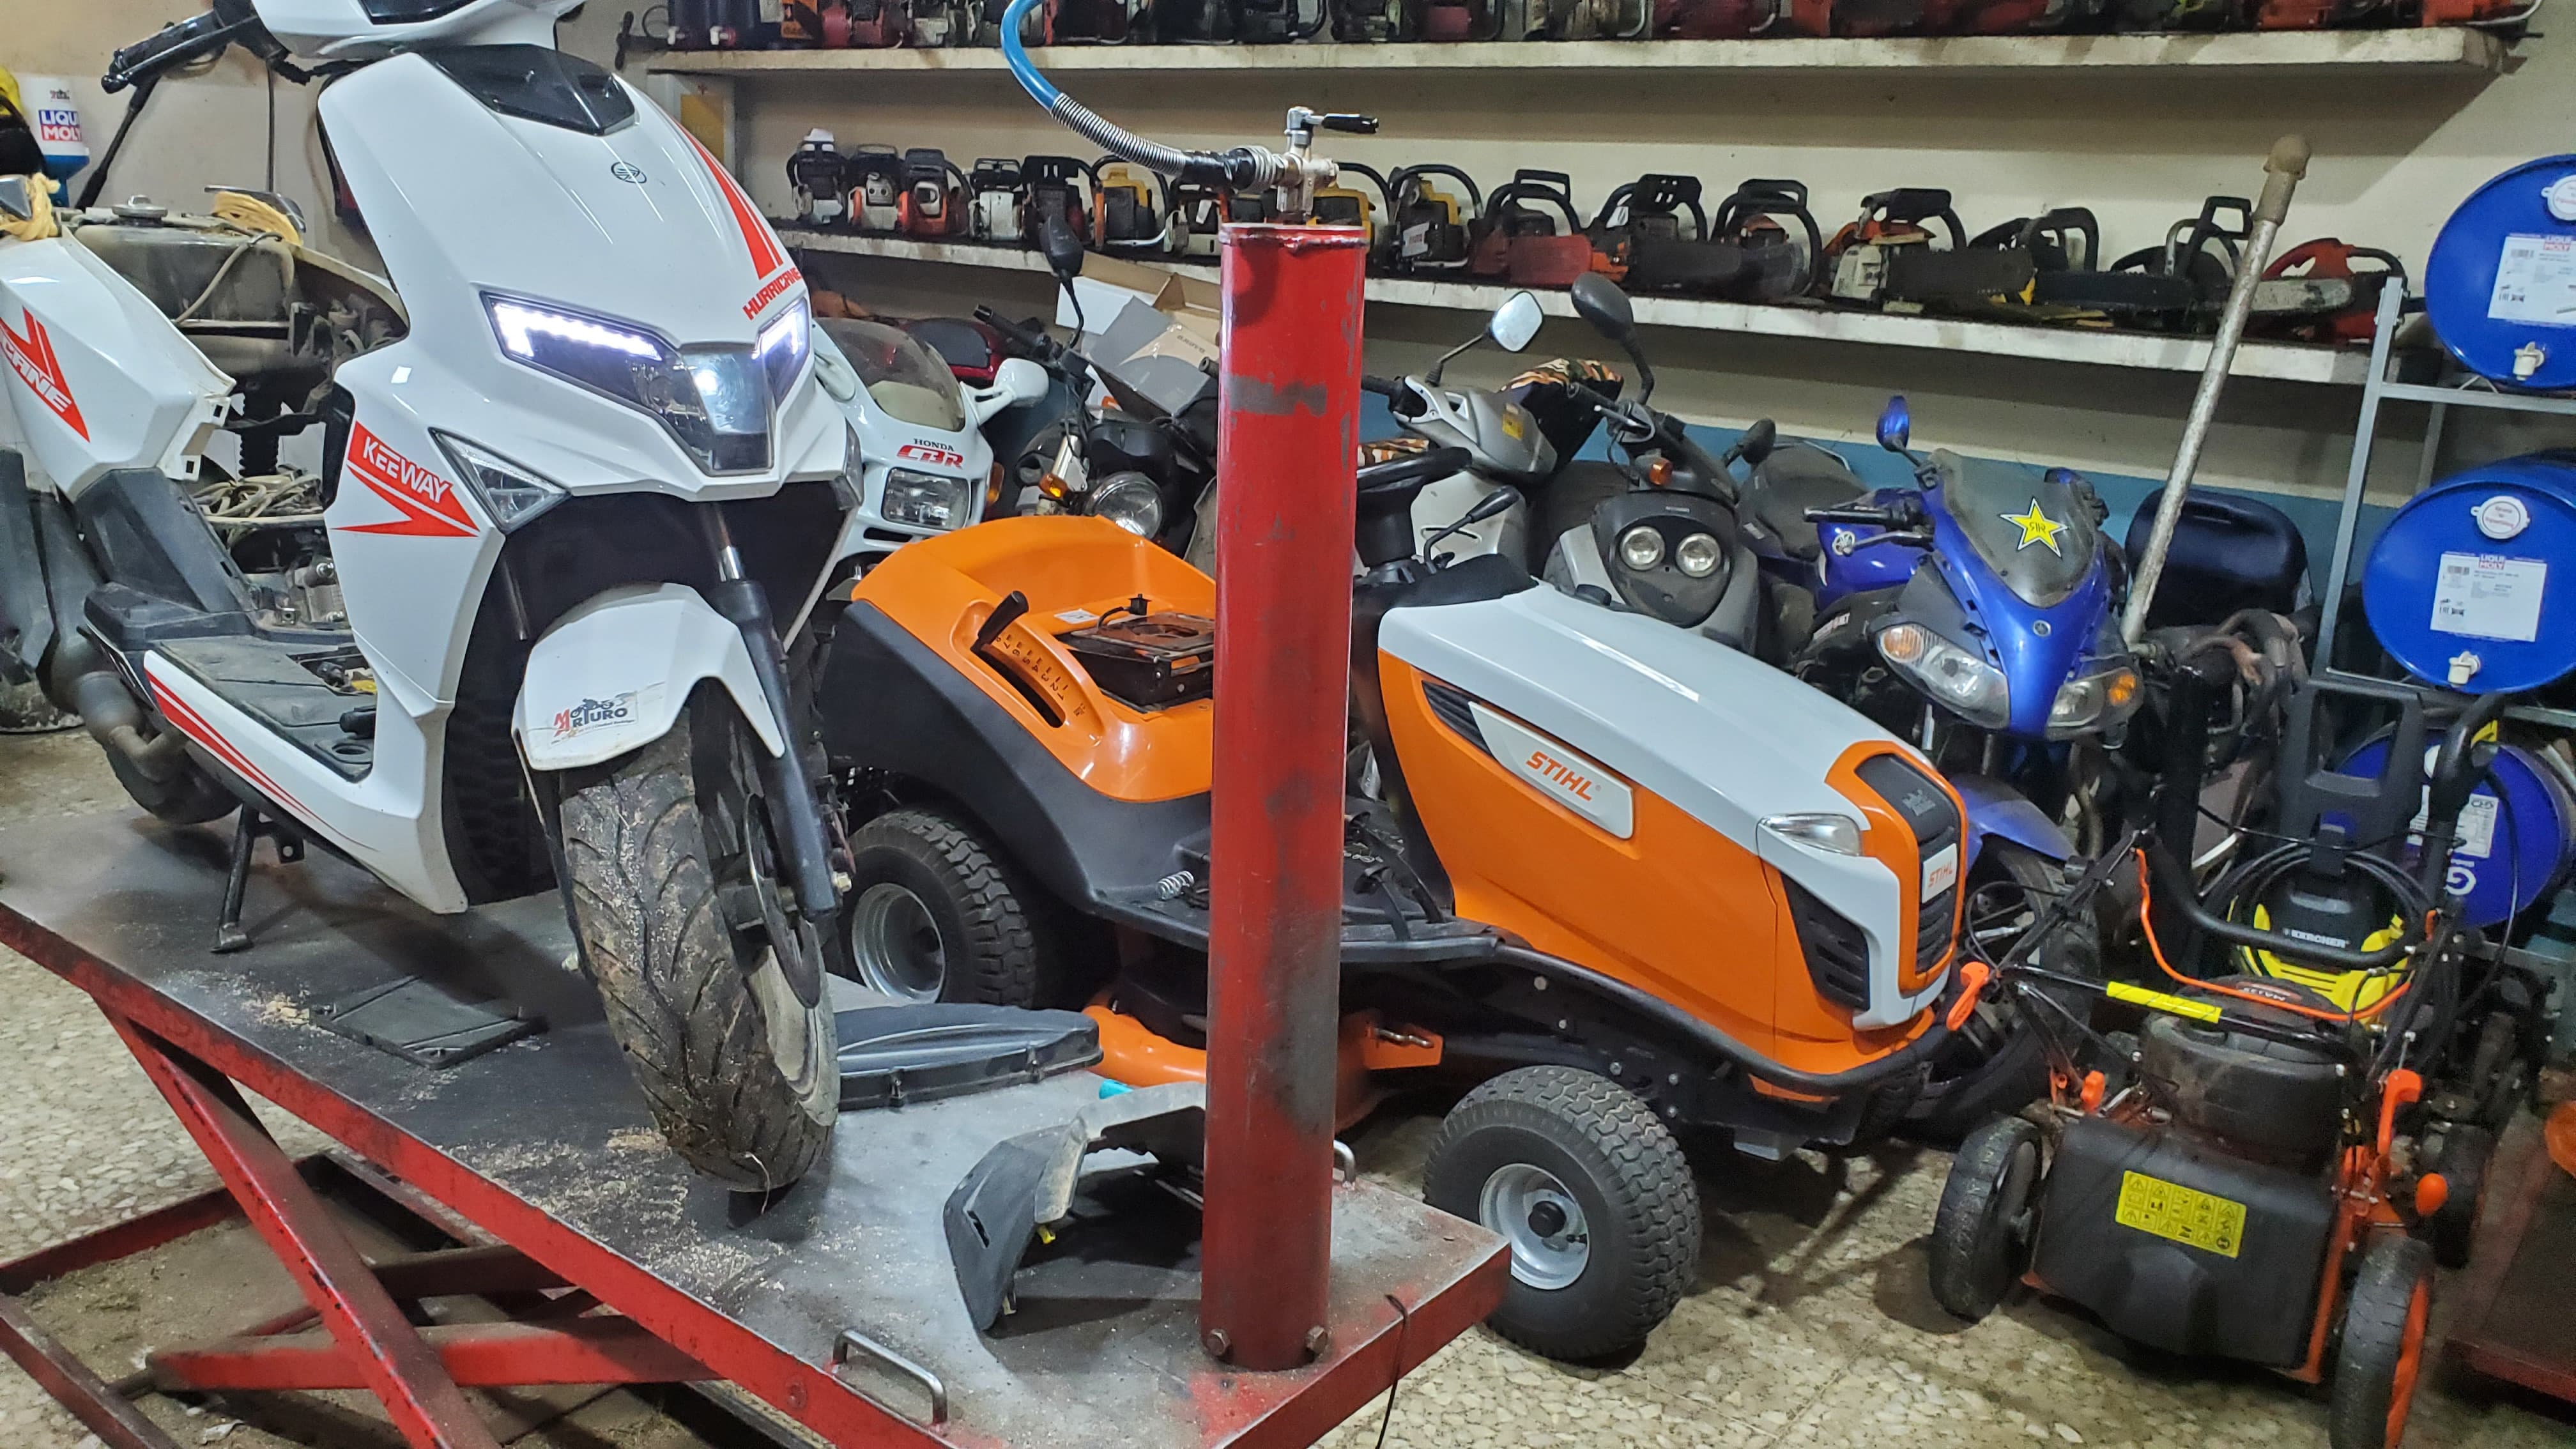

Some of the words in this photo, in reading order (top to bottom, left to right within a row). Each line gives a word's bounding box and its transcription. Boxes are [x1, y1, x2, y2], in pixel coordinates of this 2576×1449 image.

[41, 111, 77, 125] LIQU
[742, 266, 802, 320] HURRICANE
[0, 328, 72, 413] CANE
[896, 445, 963, 470] CBR
[914, 438, 954, 451] HONDA
[363, 436, 450, 503] KEEWAY
[1526, 751, 1592, 801] STIHL
[1928, 862, 1952, 888] STIHL
